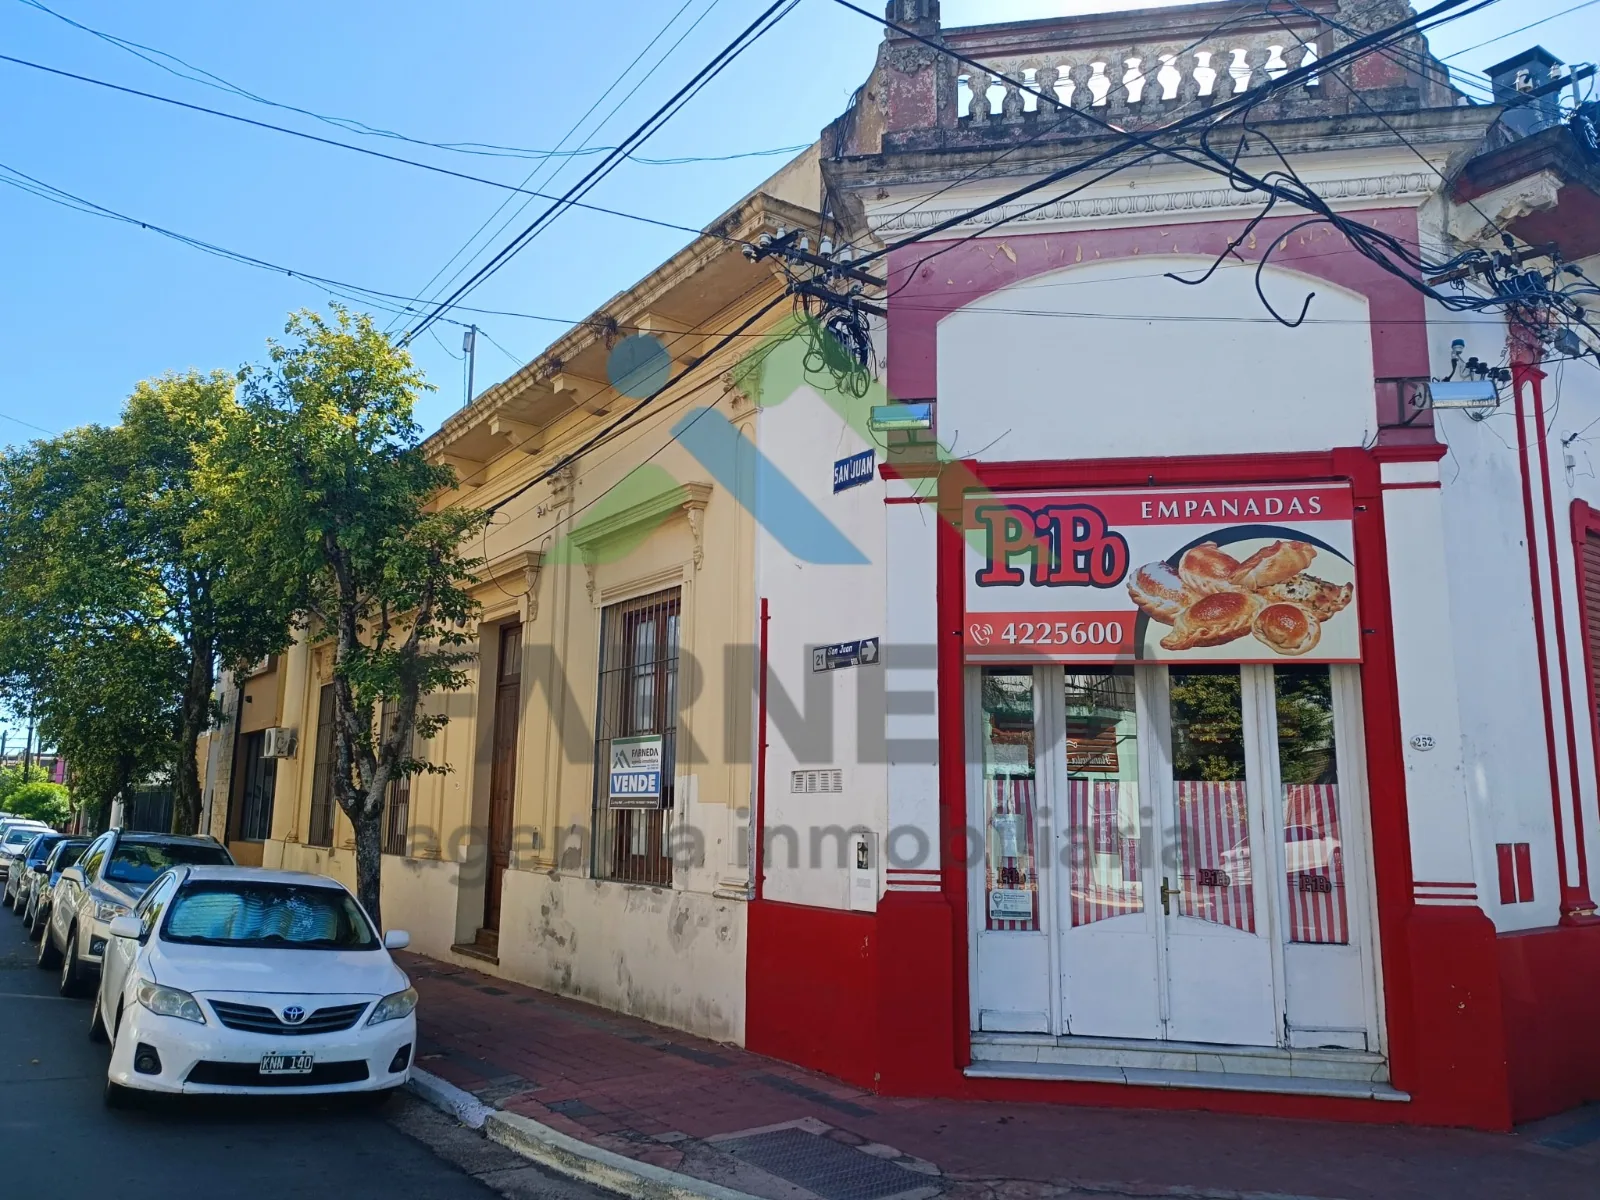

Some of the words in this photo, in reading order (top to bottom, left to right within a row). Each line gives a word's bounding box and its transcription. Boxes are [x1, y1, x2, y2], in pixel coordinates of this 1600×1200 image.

[834, 463, 849, 485] SAN
[850, 456, 873, 479] JUAN
[1141, 496, 1322, 519] EMPANADAS
[1001, 622, 1123, 645] 4225600
[827, 647, 838, 656] San
[839, 645, 853, 654] Juan
[815, 654, 824, 666] 21
[632, 748, 659, 758] FARNEDA
[613, 774, 656, 792] VENDE
[262, 1056, 285, 1070] KNN
[290, 1056, 312, 1069] 140
